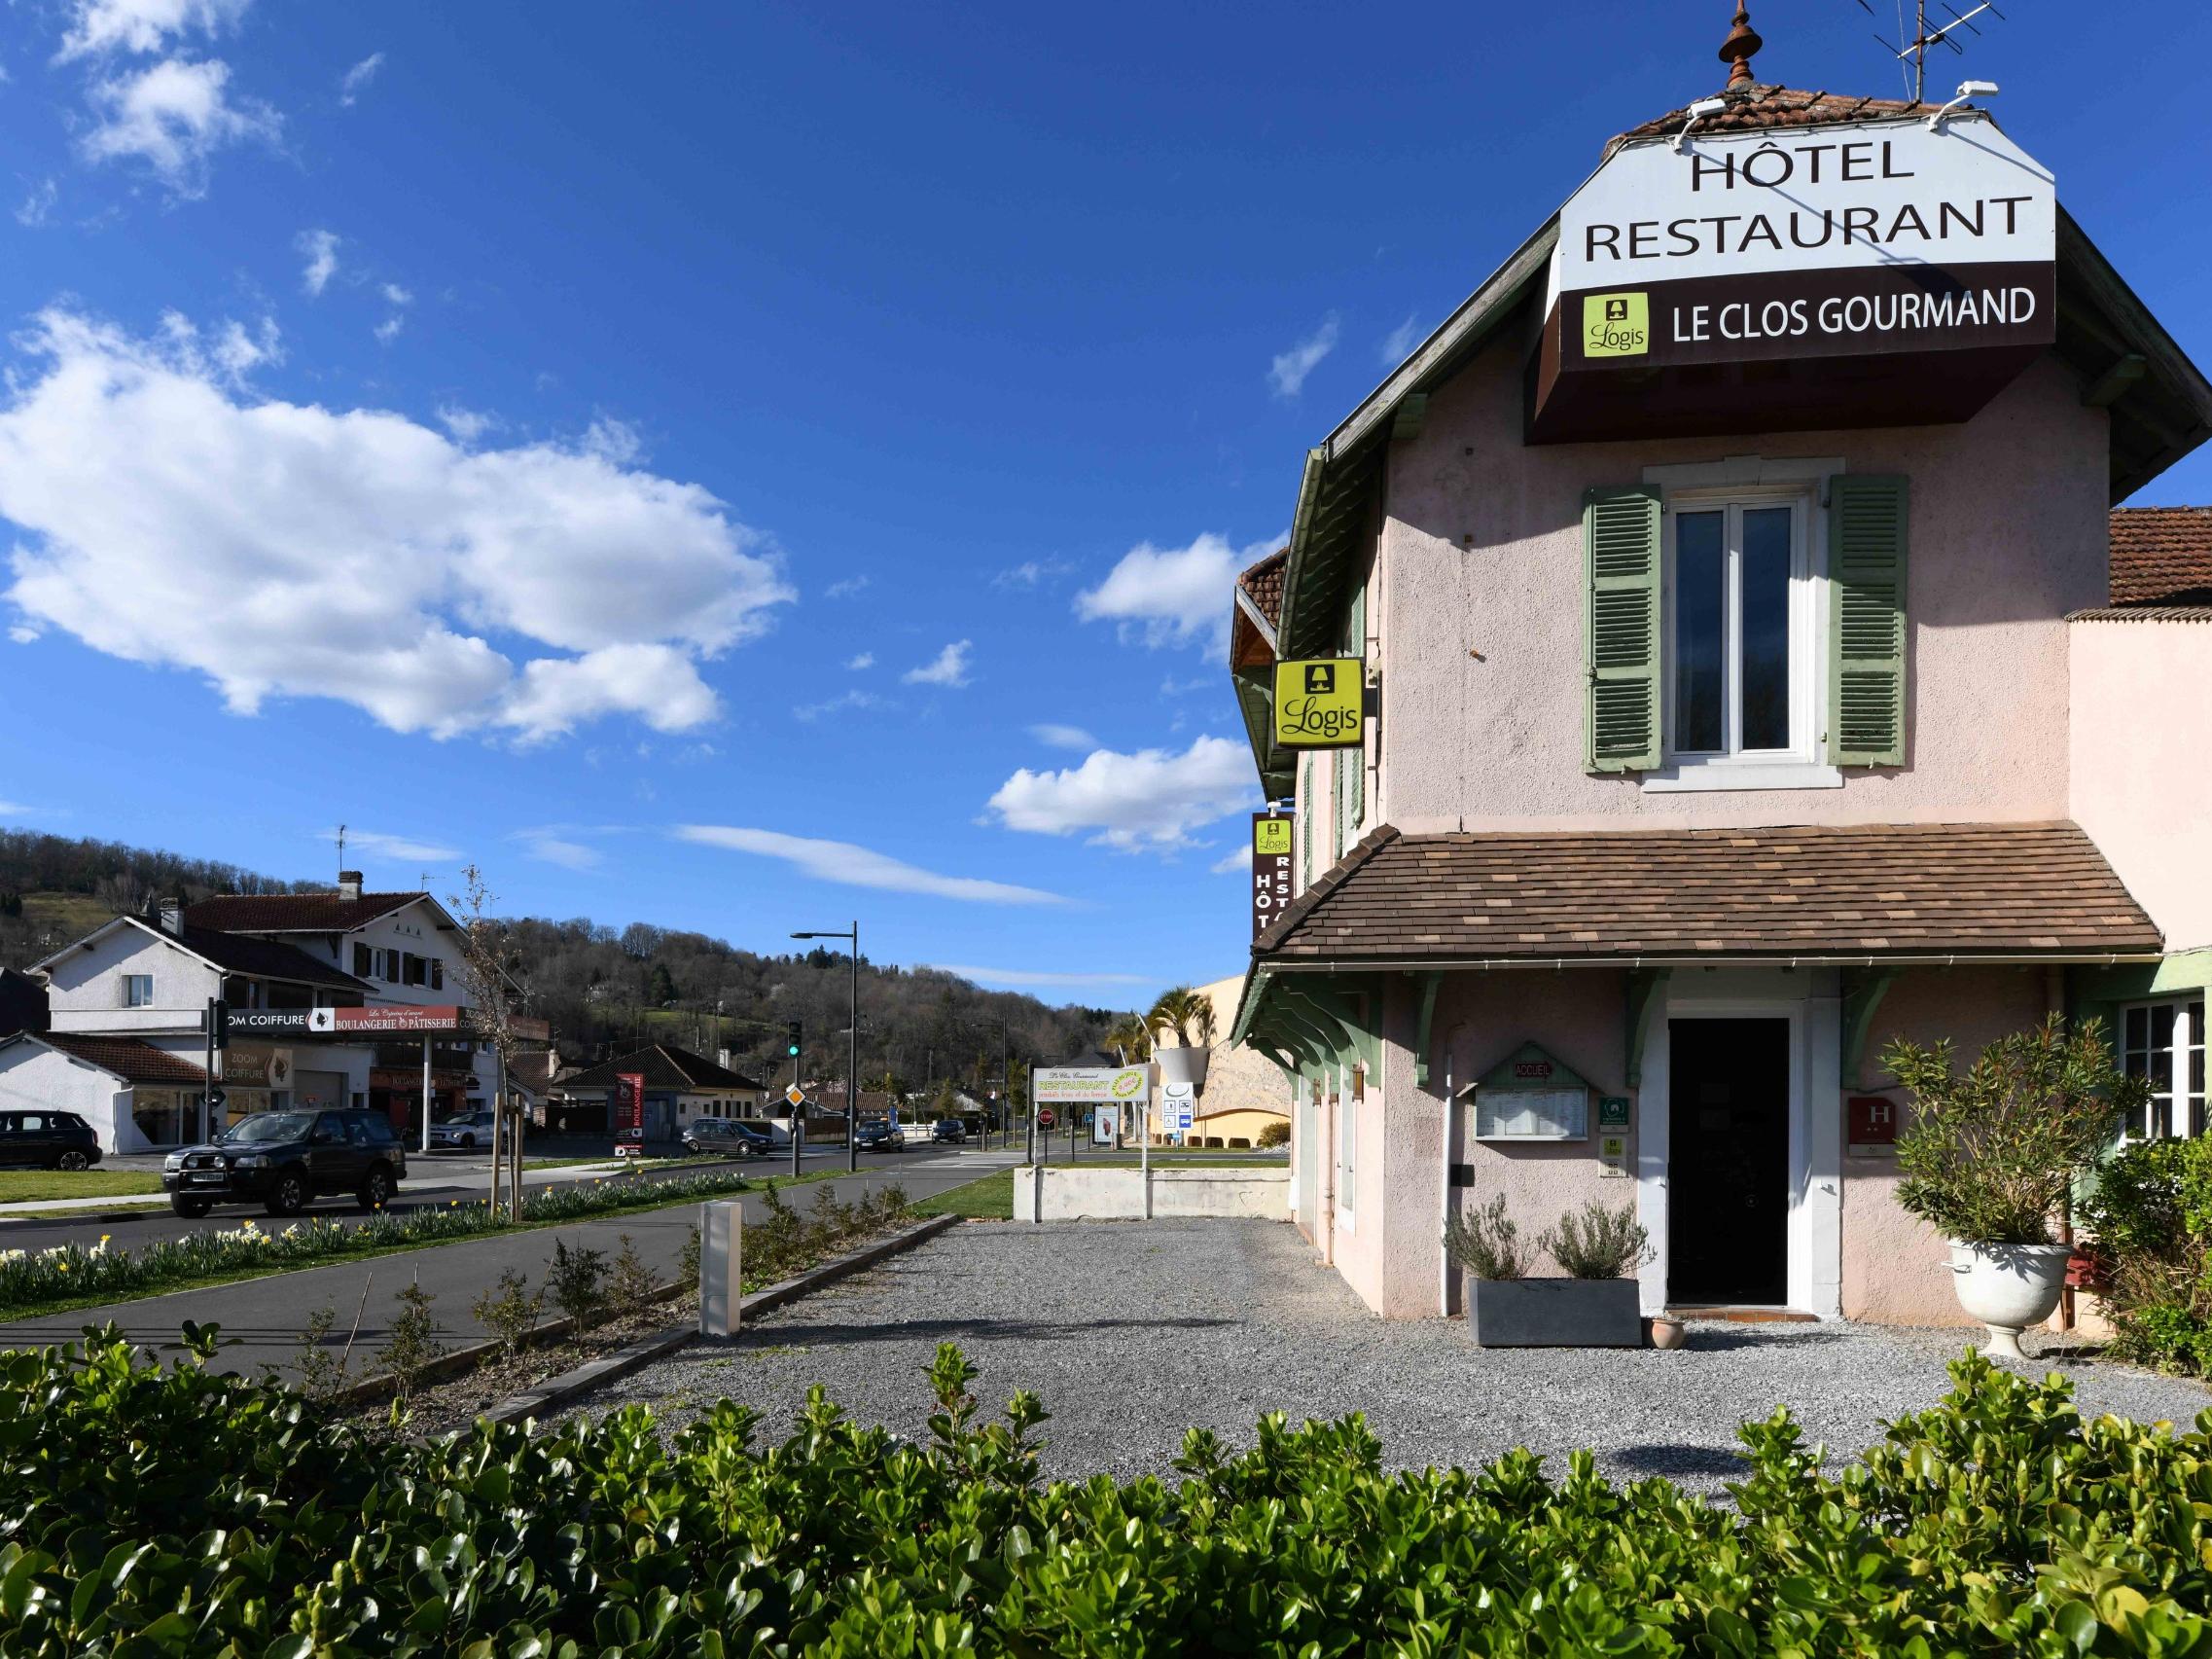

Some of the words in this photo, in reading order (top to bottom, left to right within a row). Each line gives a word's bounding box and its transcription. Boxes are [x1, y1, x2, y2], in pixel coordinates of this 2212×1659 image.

[1692, 140, 1914, 192] HÔTEL
[1586, 196, 2033, 262] RESTAURANT
[1673, 305, 1709, 343] LE
[1719, 299, 1808, 340] CLOS
[1818, 287, 2036, 334] GOURMAND
[1588, 321, 1644, 351] Logis
[1281, 696, 1358, 738] Logis
[1259, 835, 1289, 851] Logis
[1255, 874, 1271, 938] HÔT
[249, 1015, 304, 1026] COIFFURE
[336, 1019, 397, 1029] BOULANGERIE
[409, 1016, 456, 1028] PÂTISSERIE
[232, 1053, 258, 1064] ZOOM
[226, 1067, 265, 1079] COIFFURE
[1516, 1064, 1550, 1075] ACCUEIL
[1038, 1080, 1109, 1091] RESTAURANT
[1869, 1105, 1890, 1123] H
